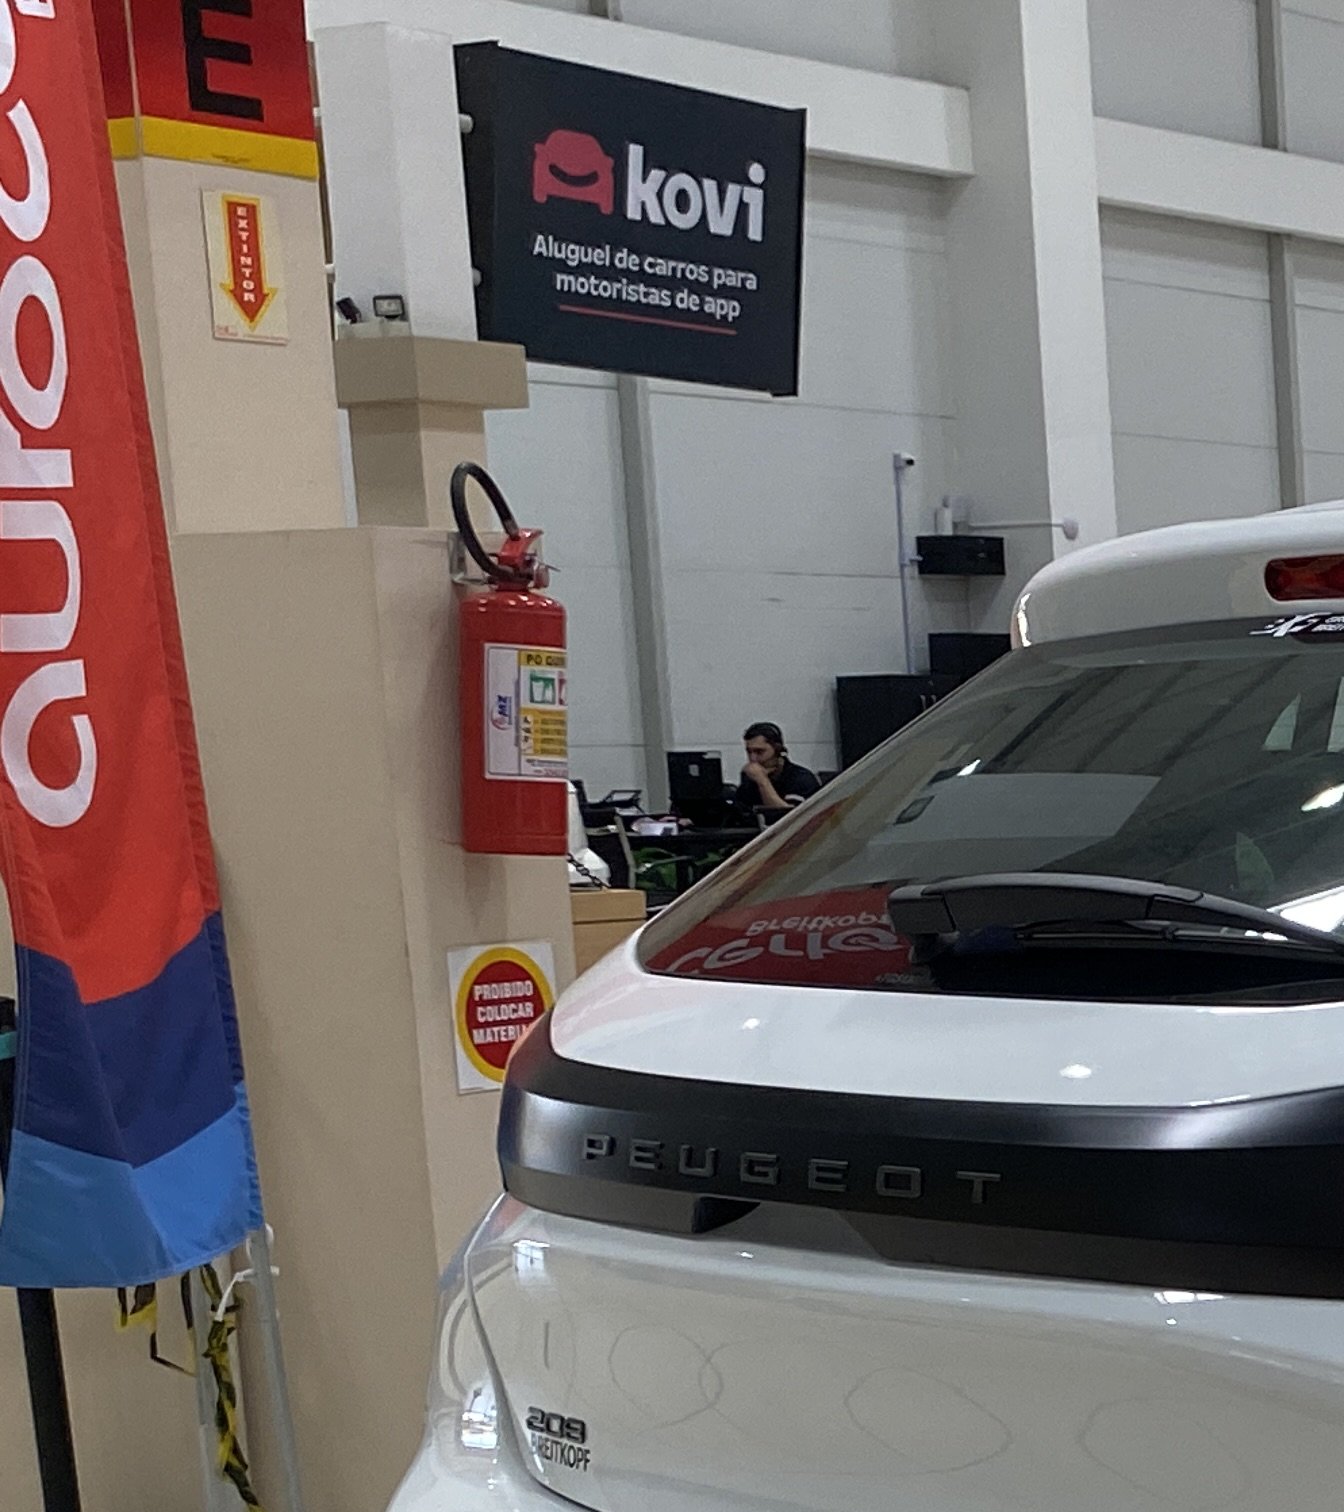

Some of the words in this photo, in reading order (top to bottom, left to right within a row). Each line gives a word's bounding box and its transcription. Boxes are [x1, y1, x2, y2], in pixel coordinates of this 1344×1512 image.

[181, 0, 265, 123] E
[625, 142, 766, 242] kovi
[236, 206, 256, 303] EXTINTOR
[532, 234, 610, 267] Aluguel
[615, 248, 640, 272] de
[643, 256, 709, 283] carros
[712, 266, 758, 290] para
[555, 272, 671, 308] motoristas
[675, 289, 701, 311] de
[703, 298, 741, 322] app
[0, 0, 97, 827] auroc
[473, 980, 534, 1002] PROIBIDO
[476, 1002, 534, 1024] COLOCAR
[583, 1133, 1002, 1204] PEUGEOT
